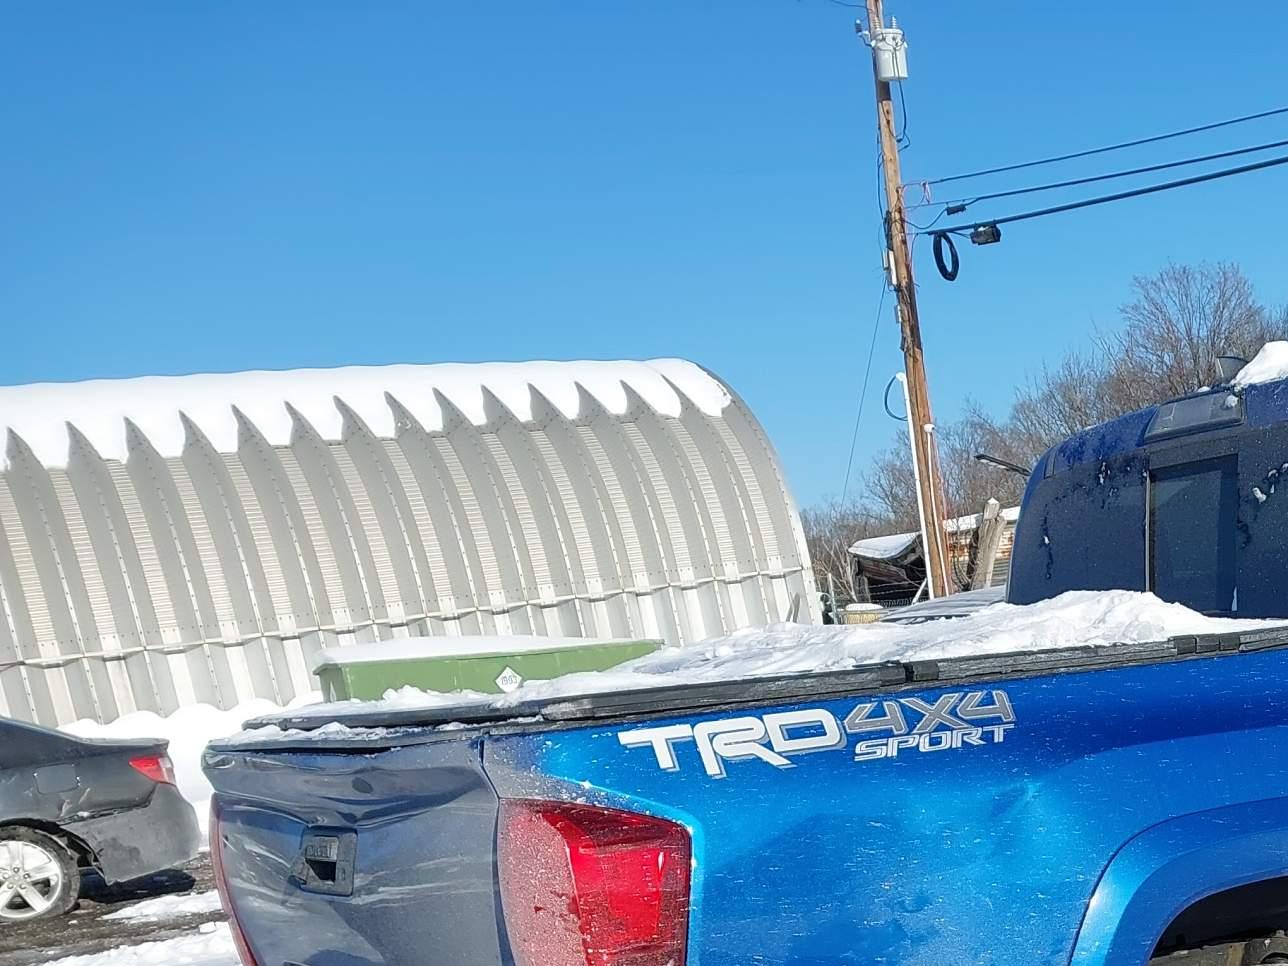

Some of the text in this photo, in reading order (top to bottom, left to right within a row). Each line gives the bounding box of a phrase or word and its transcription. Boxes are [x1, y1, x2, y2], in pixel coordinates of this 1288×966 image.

[617, 689, 1018, 779] TRD 4X4
[854, 723, 1016, 762] SPORT
